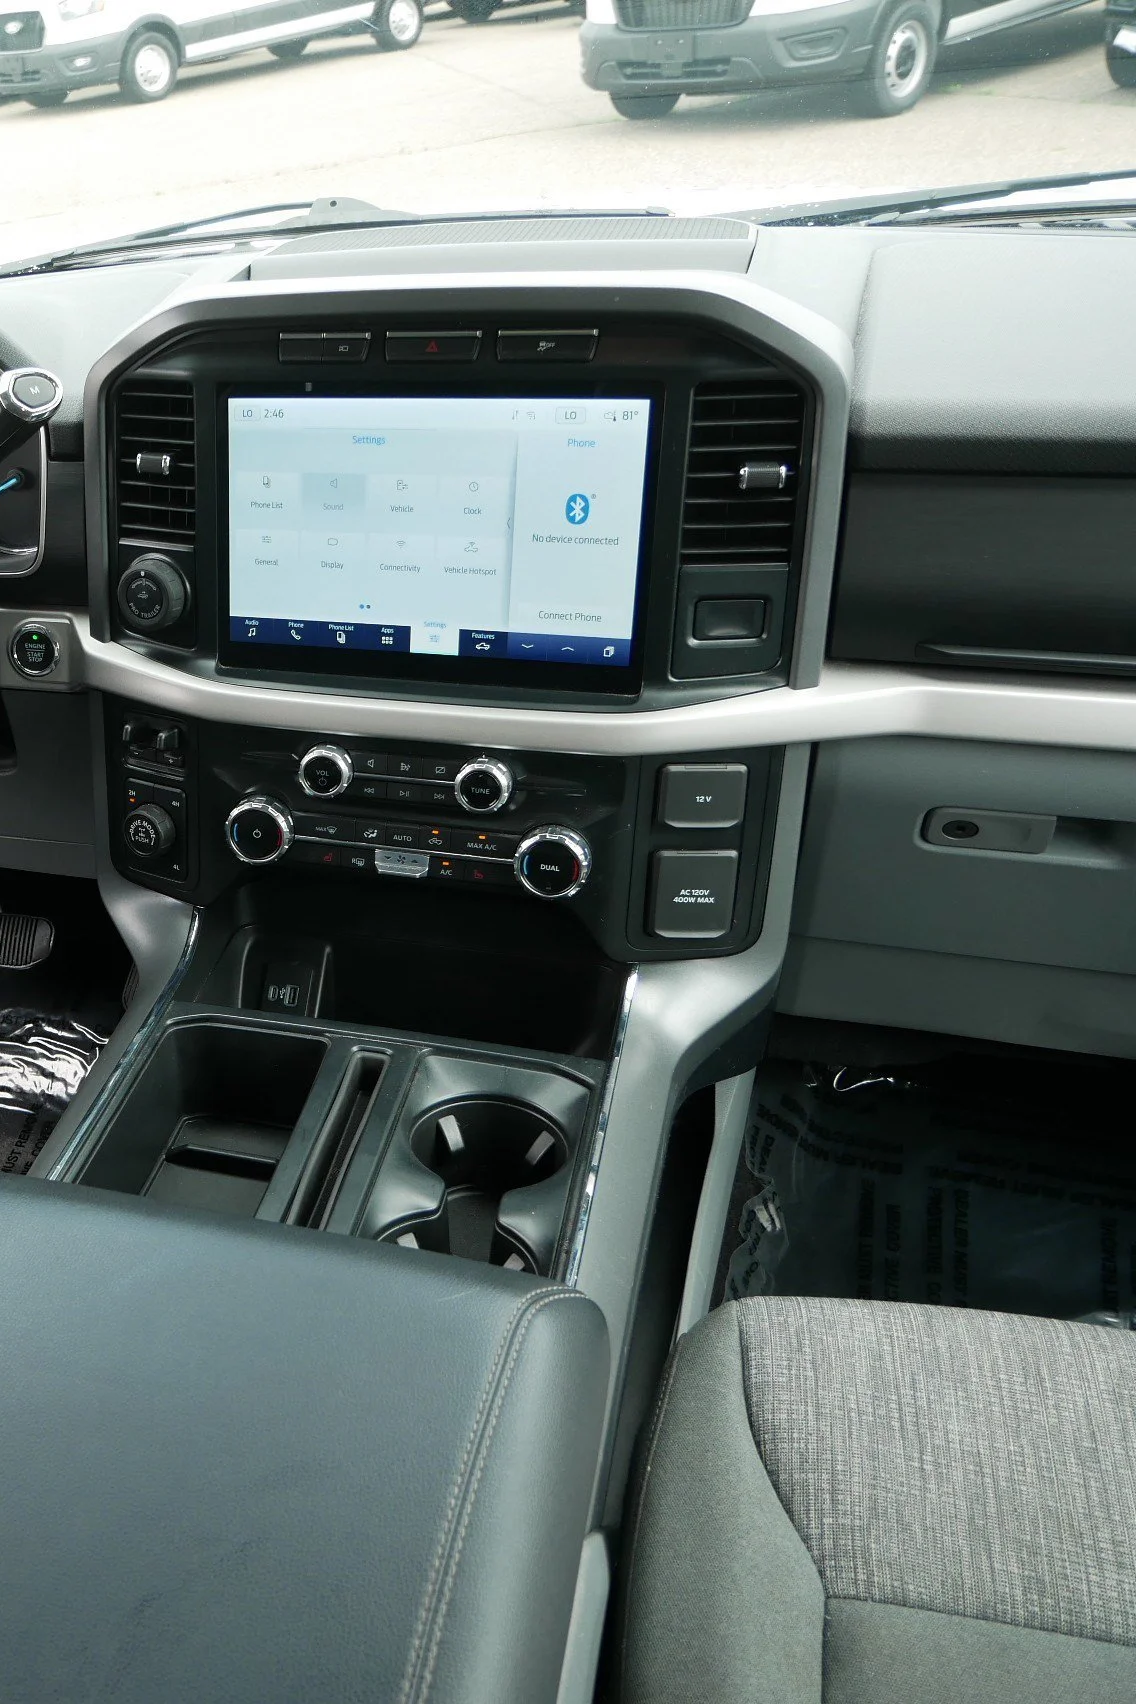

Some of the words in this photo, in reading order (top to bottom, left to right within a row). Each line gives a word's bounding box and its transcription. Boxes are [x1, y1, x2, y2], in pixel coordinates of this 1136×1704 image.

[242, 409, 253, 418] LO
[264, 409, 284, 419] 2:46
[564, 411, 577, 420] LO
[622, 410, 639, 420] 81°
[352, 435, 386, 446] Settings
[567, 438, 596, 448] Phone
[250, 501, 270, 509] Phone
[271, 501, 283, 509] List
[323, 503, 344, 511] Sound
[390, 505, 414, 513] Vehicle
[463, 507, 482, 515] Clock
[532, 534, 544, 543] No
[545, 534, 573, 544] device
[574, 536, 619, 546] connected
[254, 558, 279, 566] General
[321, 560, 344, 570] Display
[379, 563, 421, 573] Connectivity
[444, 566, 468, 575] Vehicle
[469, 567, 497, 576] Hotspot
[129, 602, 139, 615] PRO
[140, 604, 161, 619] TRAILER
[538, 610, 573, 621] Connect
[574, 612, 602, 623] Phone
[244, 619, 259, 627] Audio
[288, 621, 304, 629] Phone
[423, 621, 447, 630] Settings
[381, 627, 394, 635] Apps
[471, 632, 495, 640] Features
[315, 769, 330, 777] VOL
[128, 789, 136, 797] 2H
[471, 787, 491, 795] TUNE
[129, 819, 142, 833] DRIVE
[142, 820, 156, 838] MODE
[135, 836, 149, 844] PUSH
[393, 834, 412, 842] AUTO
[467, 841, 483, 849] MAX
[484, 843, 497, 851] A/C
[540, 863, 560, 872] DUAL
